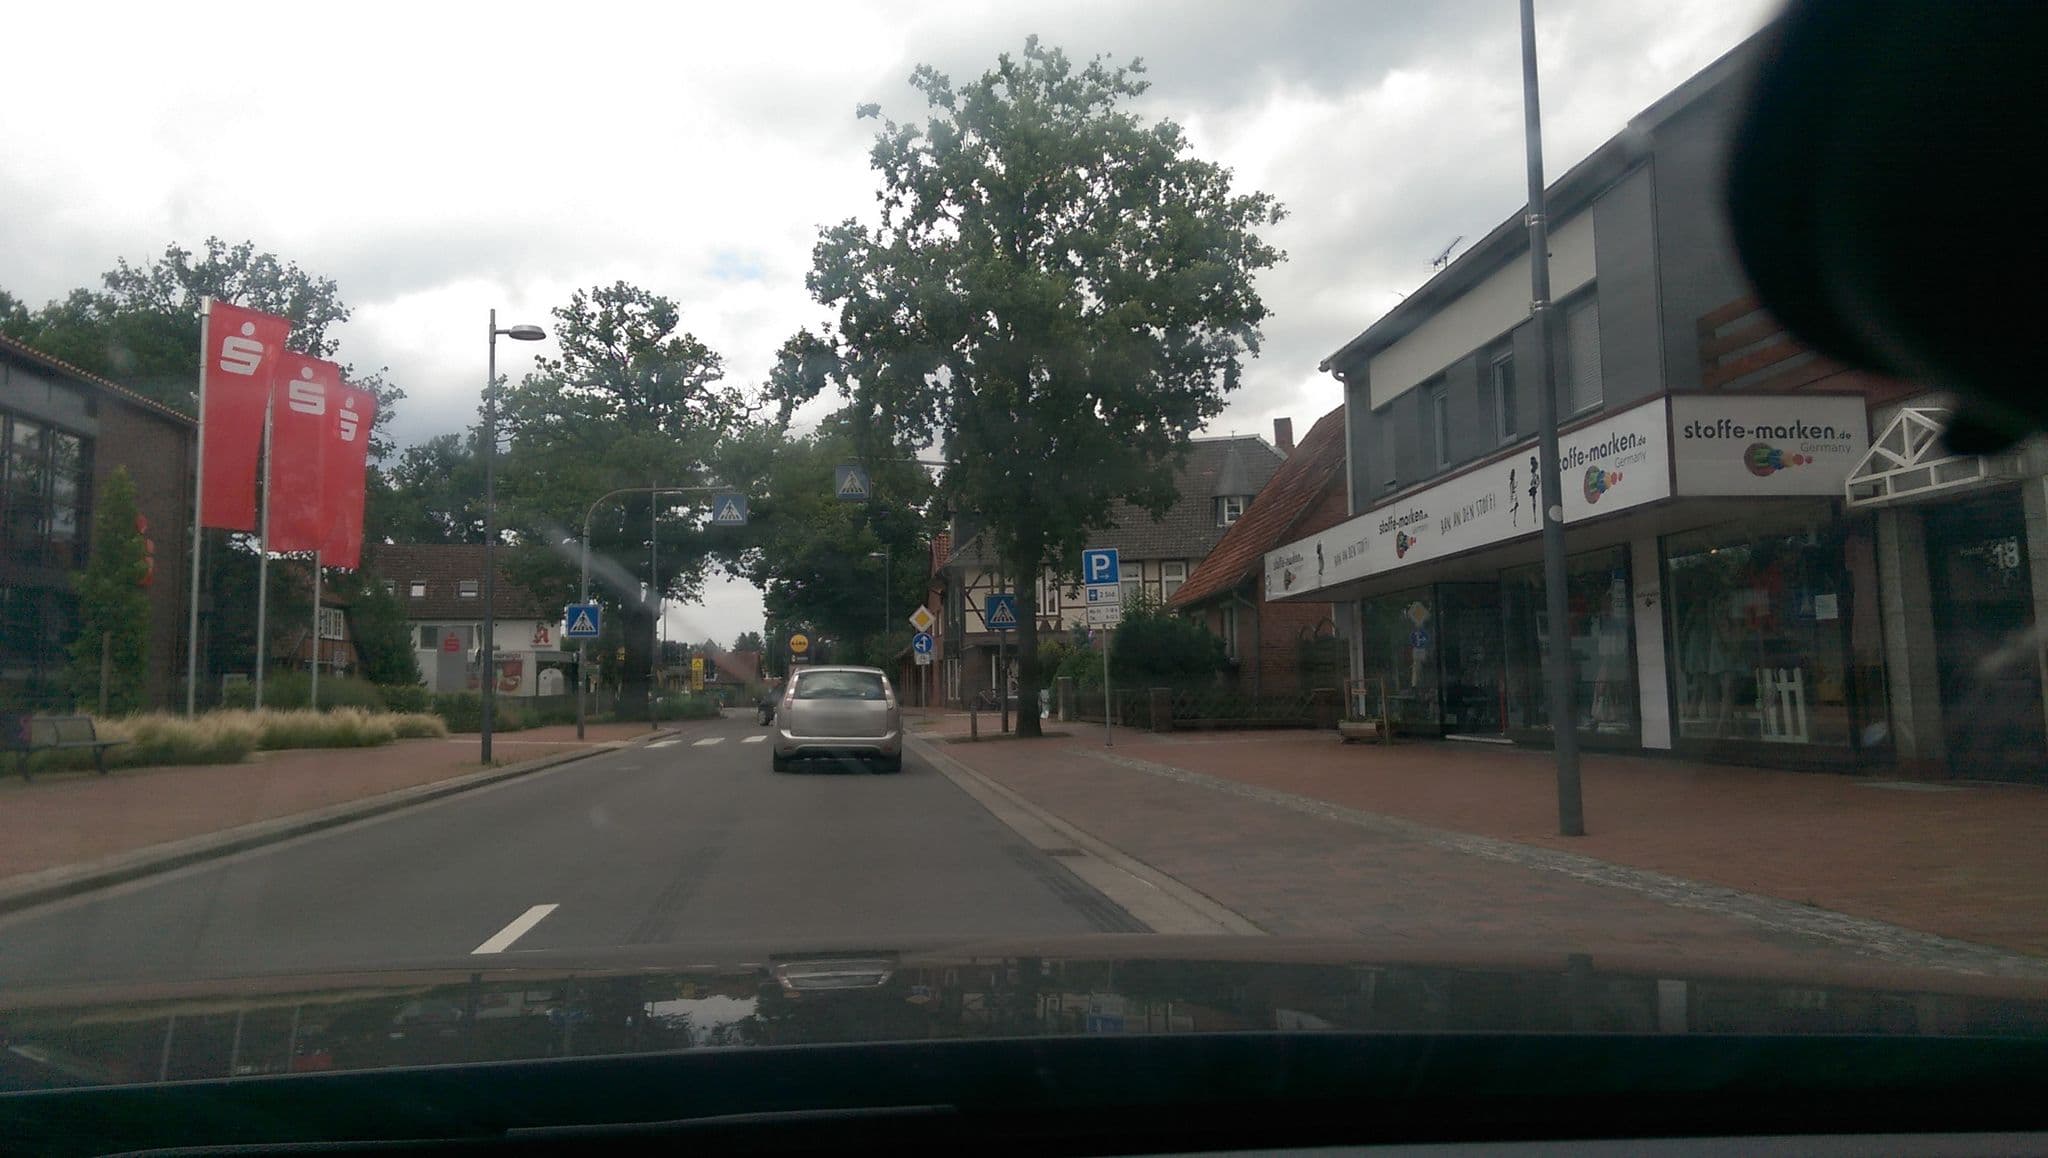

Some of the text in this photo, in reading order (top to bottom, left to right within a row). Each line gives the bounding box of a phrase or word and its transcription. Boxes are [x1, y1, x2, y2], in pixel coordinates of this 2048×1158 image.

[1684, 419, 1852, 439] stoffe-marken.de
[1558, 431, 1647, 473] offe-marken.de
[1800, 442, 1852, 454] Germany
[1615, 450, 1647, 469] Germany
[1091, 554, 1110, 580] P
